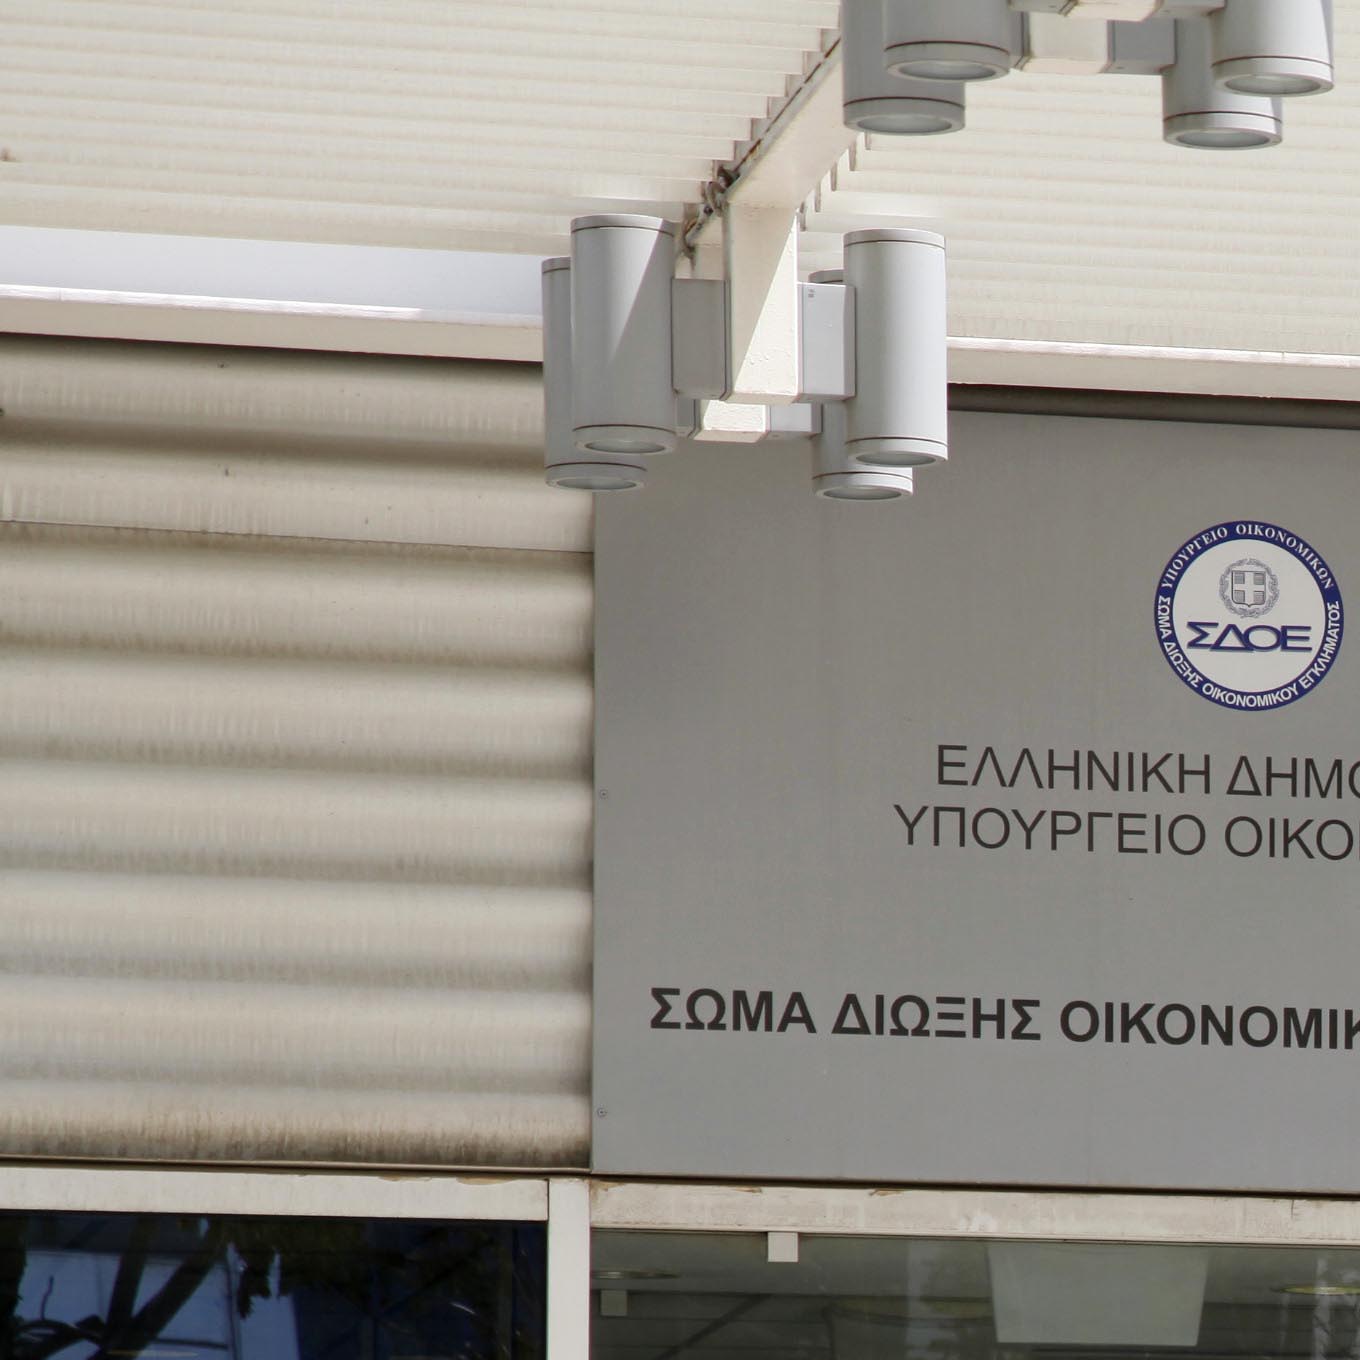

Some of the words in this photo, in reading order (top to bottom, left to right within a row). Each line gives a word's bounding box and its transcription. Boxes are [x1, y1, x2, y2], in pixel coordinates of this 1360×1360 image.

[1161, 526, 1229, 590] ΥΠΟΥΡΓΕΙΟ
[1235, 524, 1334, 590] ΟΙΚΟΝΟΜΙΚΩΝ
[1157, 595, 1173, 640] ΣΩΜΑ
[1186, 621, 1313, 652] ΣΔΟΕ
[1163, 641, 1203, 688] ΔΙΩΞΗΣ
[1299, 600, 1341, 691] ΕΓΚΛΗΜΑΤΟΣ
[1202, 683, 1299, 708] ΟΙΚΟΝΟΜΙΚΟΥ
[937, 744, 1211, 796] ΕΛΛΗΝΙΚΗ
[893, 804, 1206, 856] ΥΠΟΥΡΓΕΙΟ
[650, 987, 817, 1034] ΣΩΜΑ
[831, 993, 1041, 1041] ΔΙΩΞΗΣ
